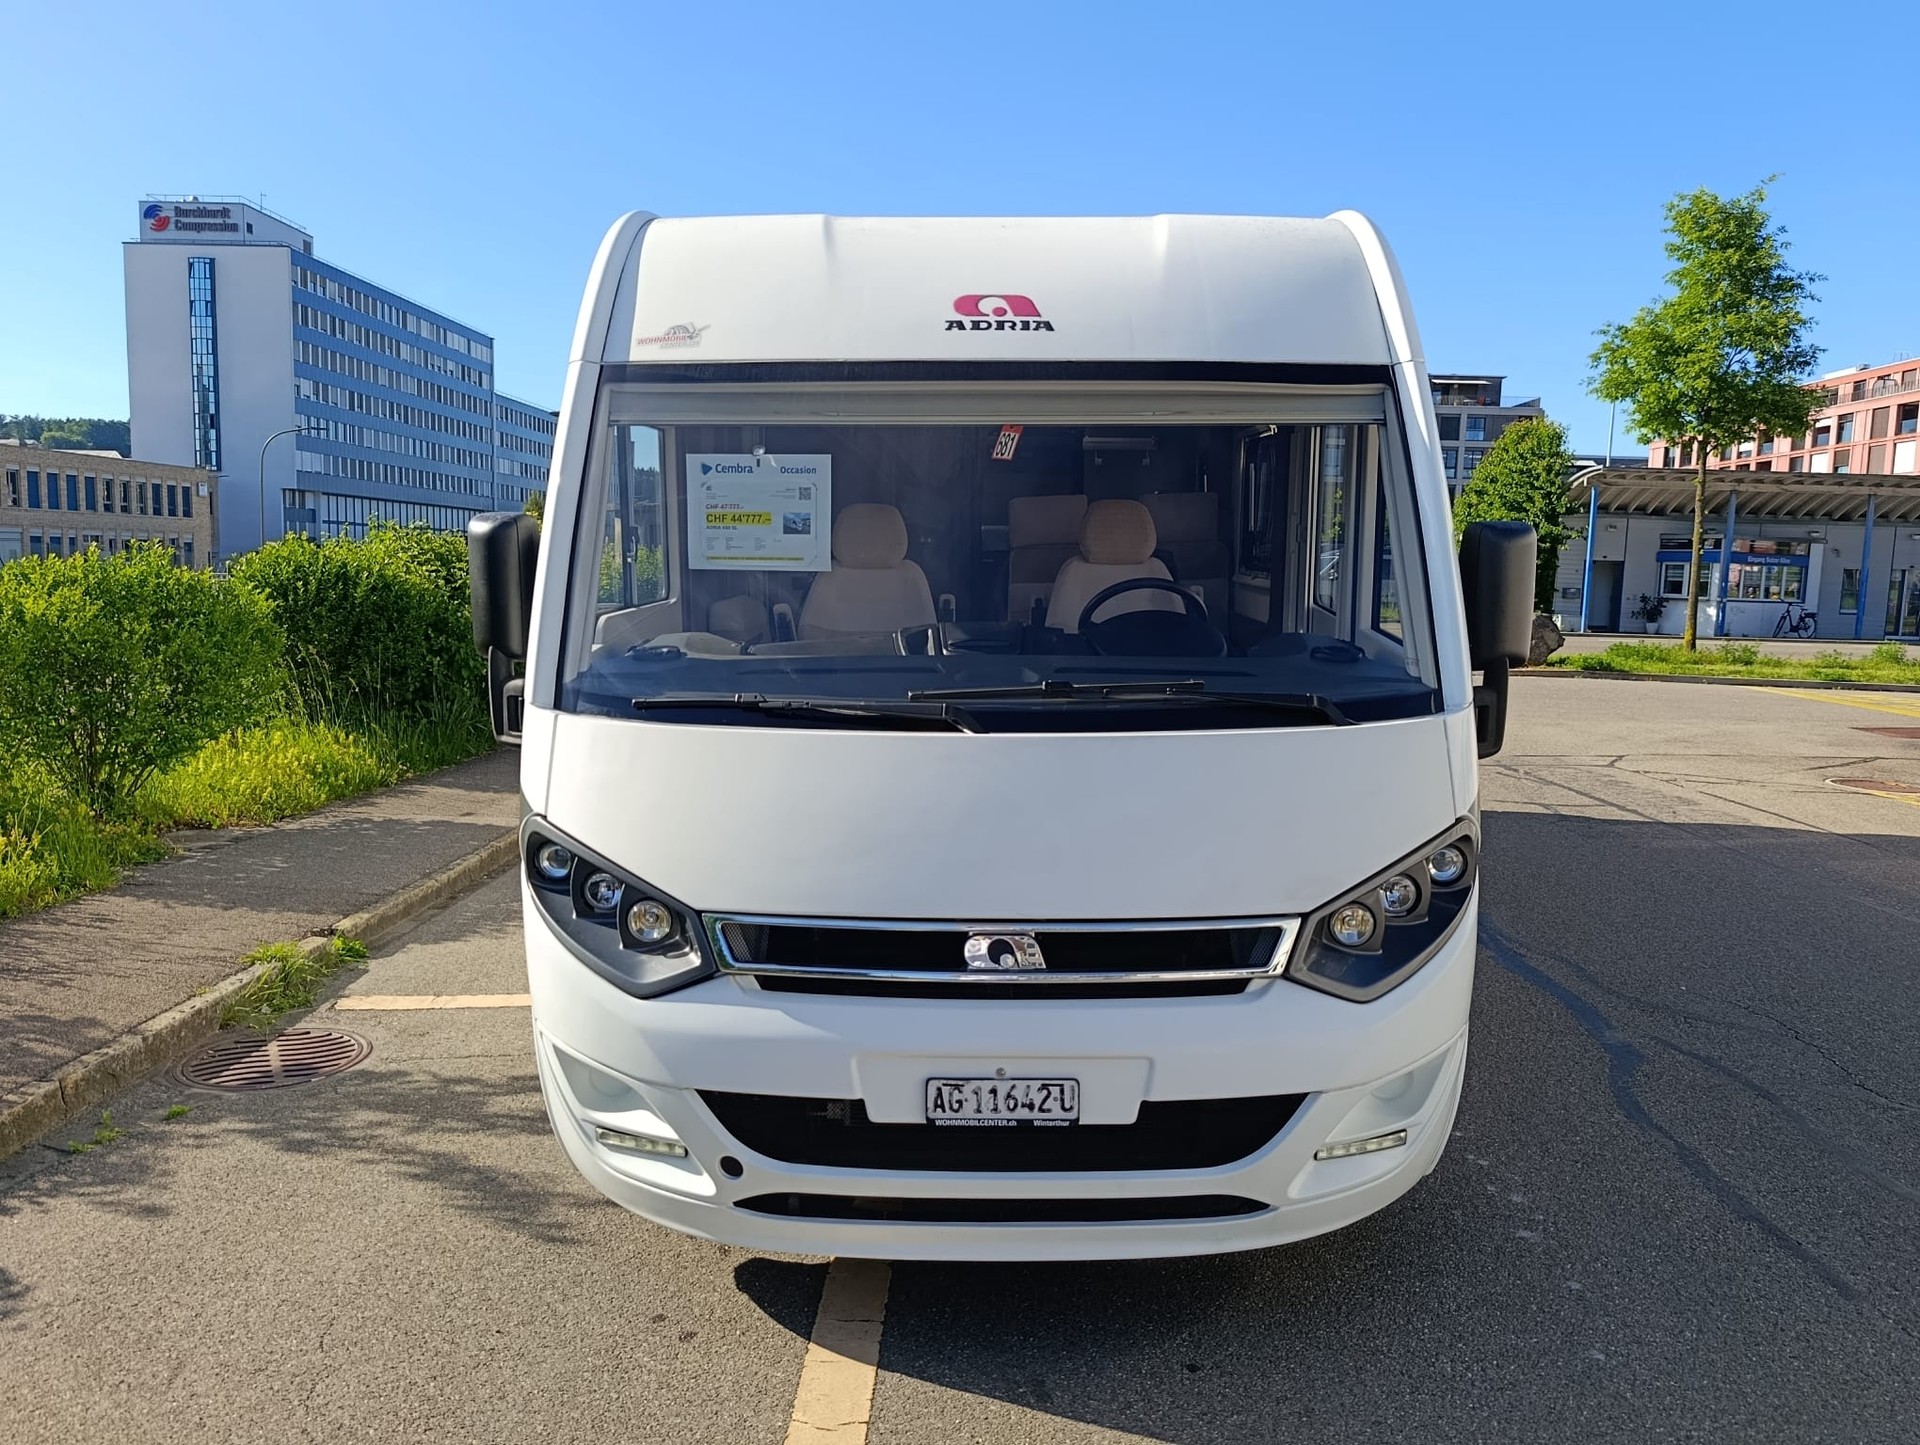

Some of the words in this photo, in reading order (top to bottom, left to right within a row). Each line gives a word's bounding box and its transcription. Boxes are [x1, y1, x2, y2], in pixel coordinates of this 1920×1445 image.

[174, 206, 231, 219] Burckhardt
[174, 219, 239, 233] Compression
[945, 320, 1055, 332] ADRIA
[995, 432, 1017, 457] 681
[715, 463, 754, 474] Cembra
[780, 466, 817, 475] Occasion
[706, 513, 728, 523] CHF
[935, 1119, 1017, 1127] WOHNMOBILCENTER.ch
[1033, 1119, 1070, 1127] Winterthur
